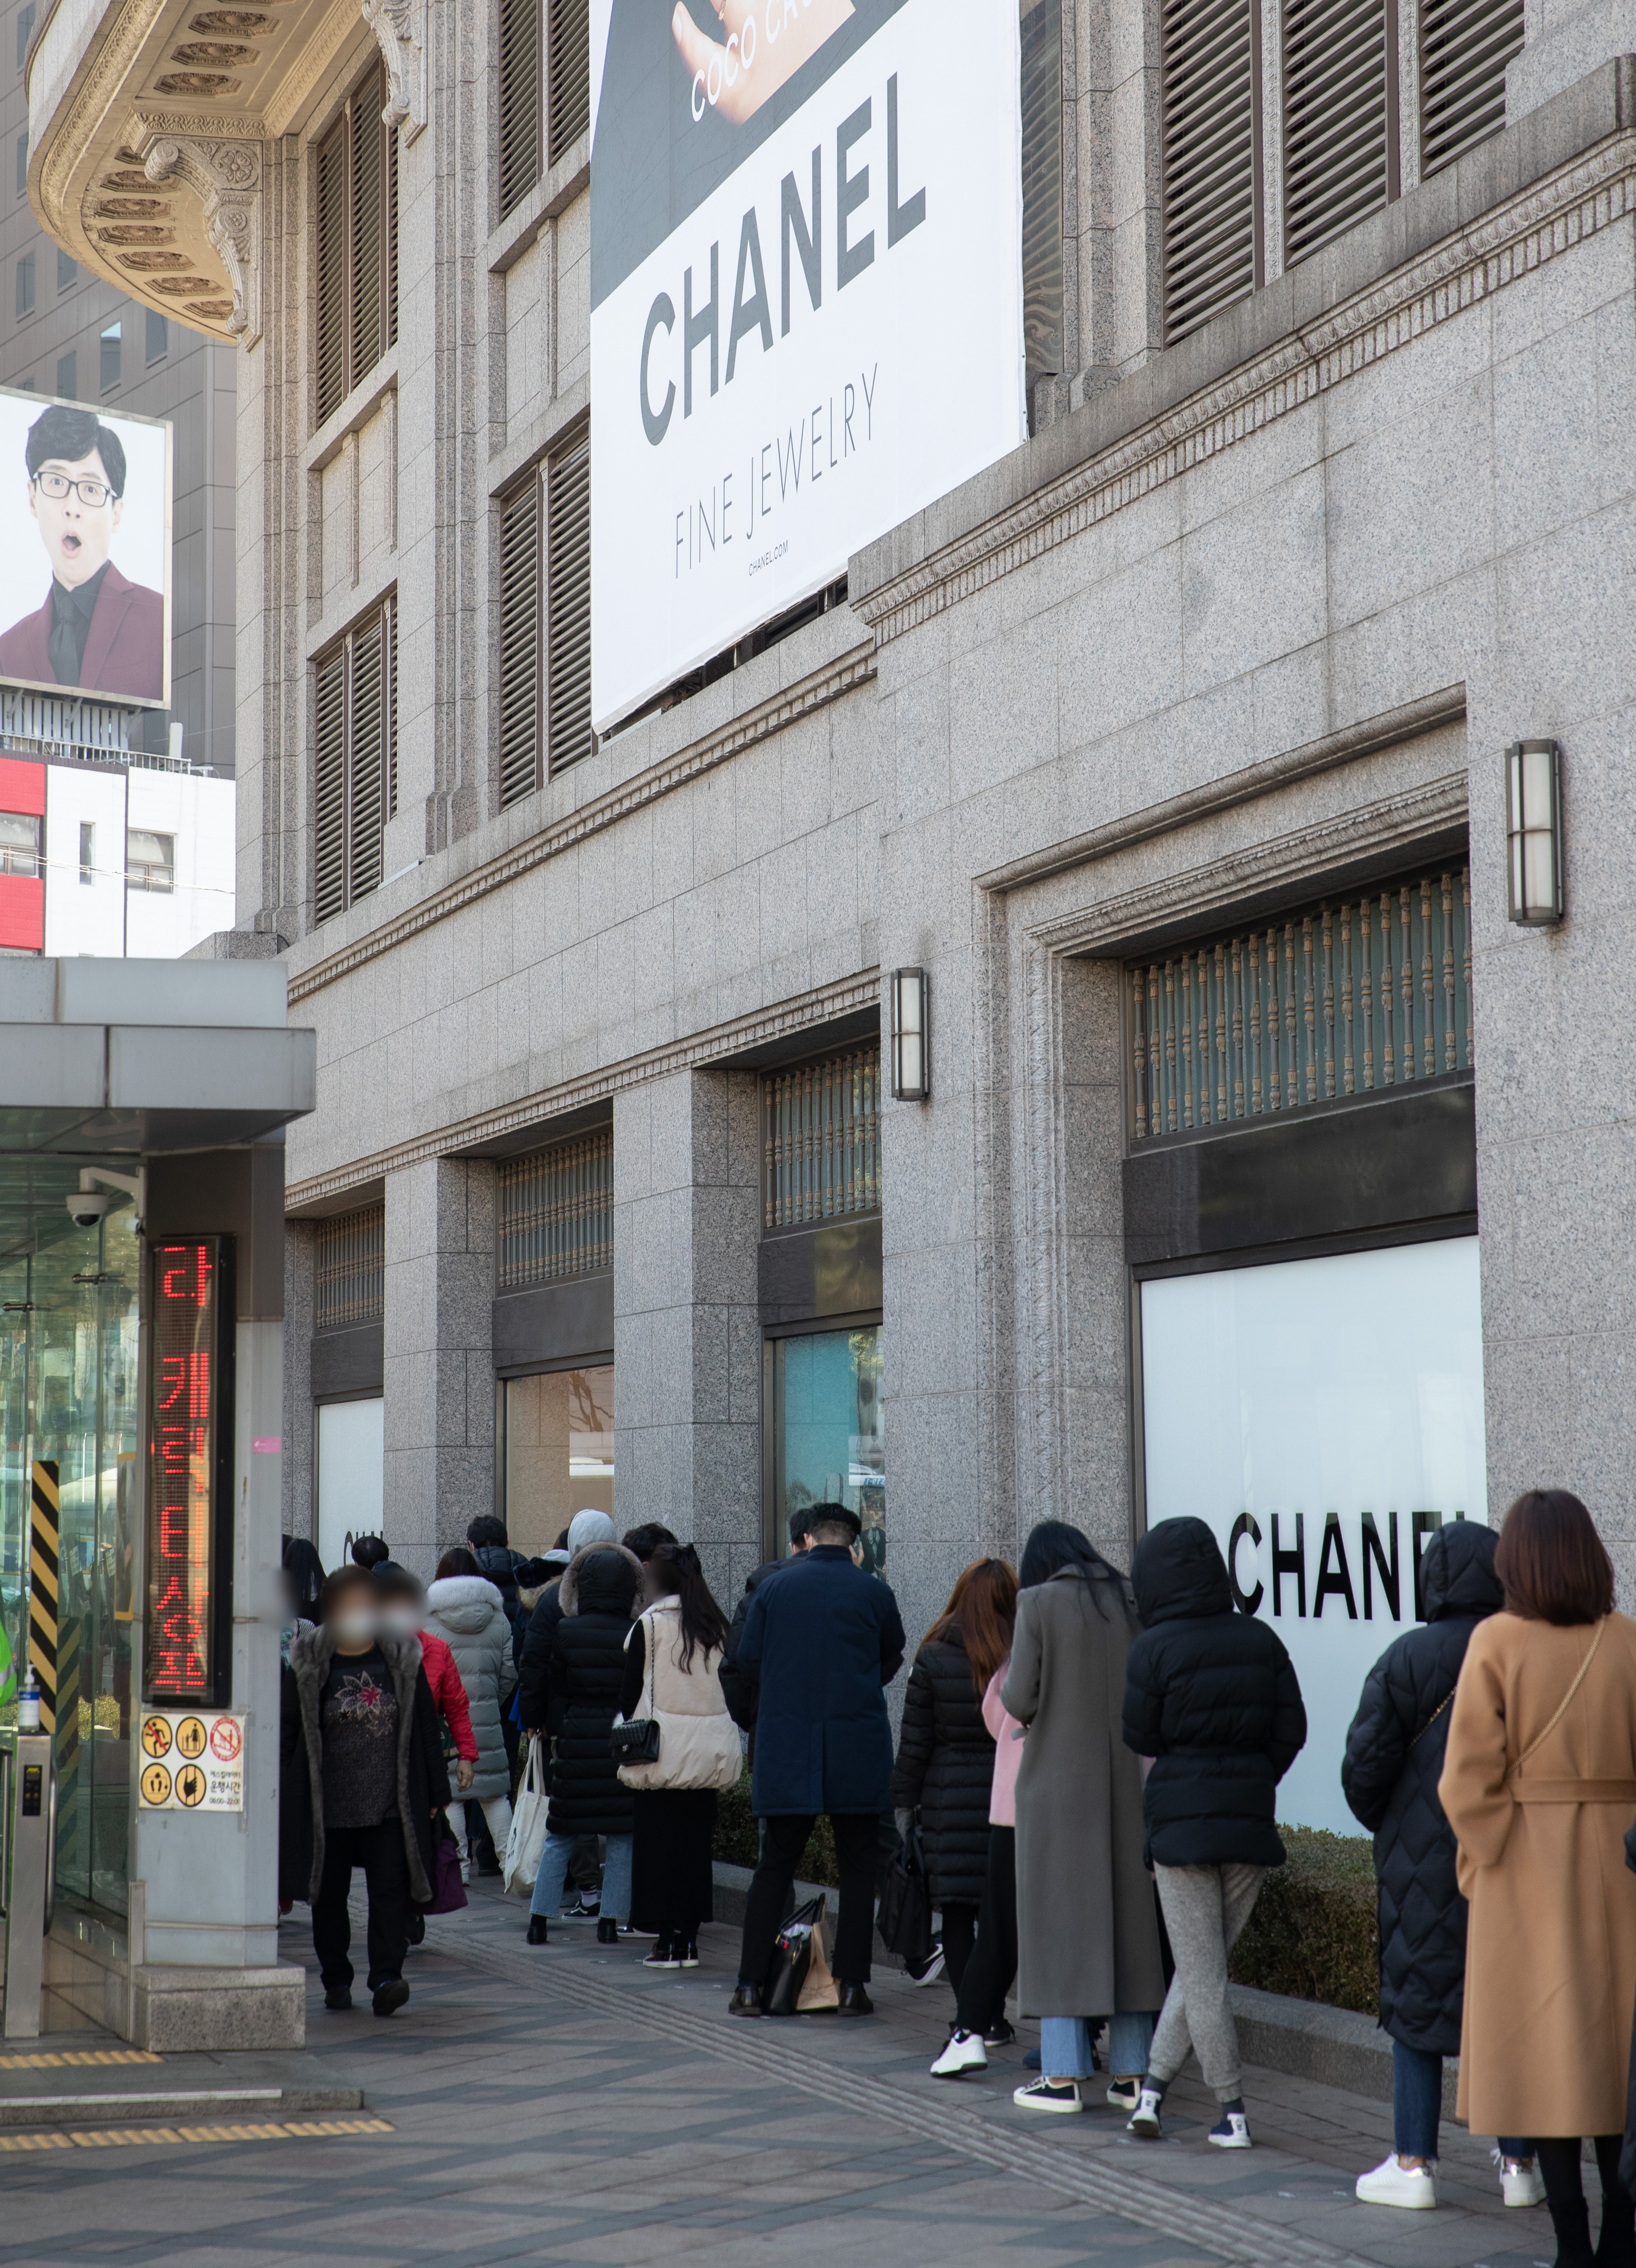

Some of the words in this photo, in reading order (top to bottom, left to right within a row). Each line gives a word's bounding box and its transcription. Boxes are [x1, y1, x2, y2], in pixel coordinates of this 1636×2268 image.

[691, 15, 756, 122] COCO
[640, 71, 926, 446] CHANEL
[676, 473, 732, 578] FINE
[746, 363, 878, 540] JEWELRY
[748, 540, 788, 576] CHANEL.COM
[210, 1780, 241, 1795] 운행시간
